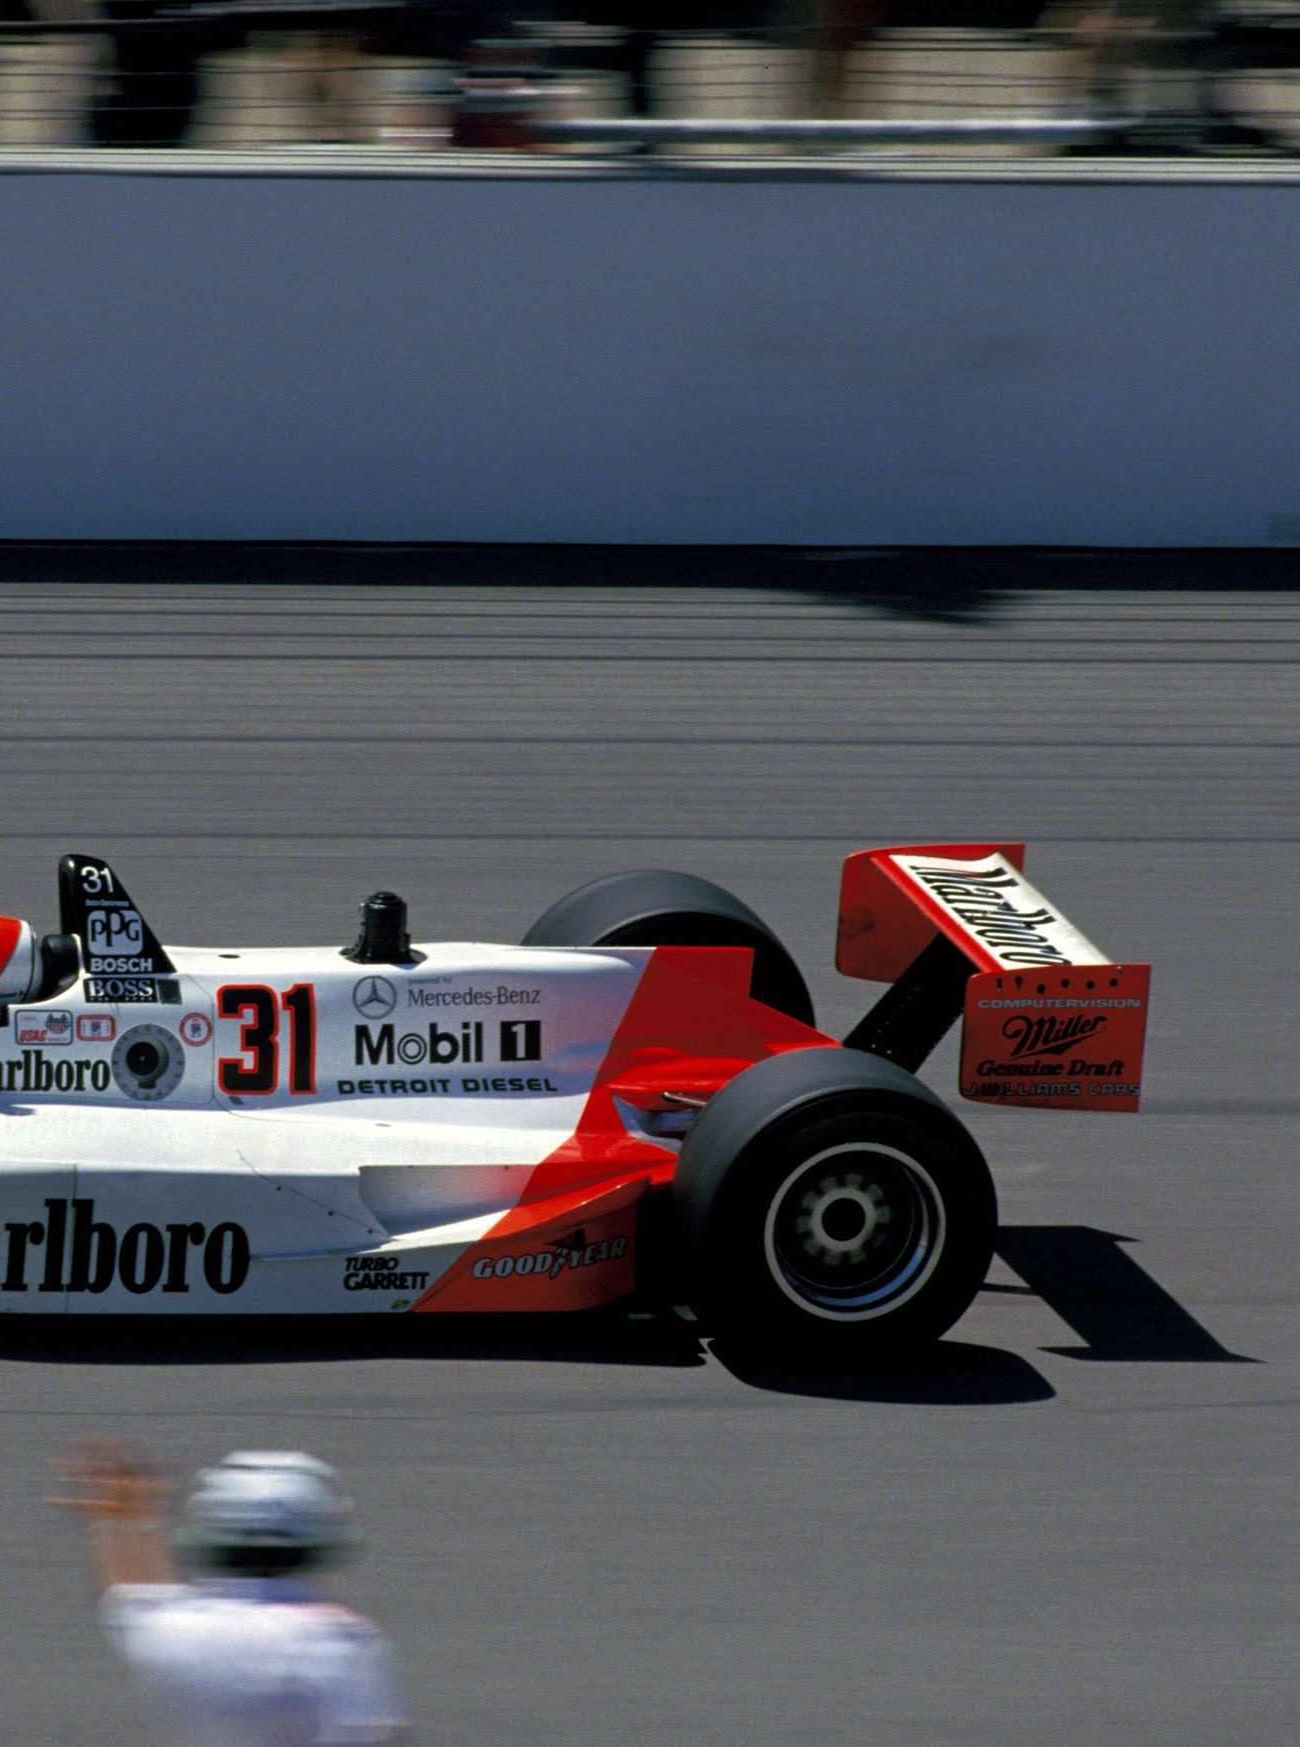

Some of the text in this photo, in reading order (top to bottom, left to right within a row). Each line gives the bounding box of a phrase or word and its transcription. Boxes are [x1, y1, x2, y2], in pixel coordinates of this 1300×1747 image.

[80, 866, 114, 893] 31
[908, 867, 1072, 964] Marlboro
[90, 911, 140, 947] PPG
[90, 958, 152, 972] BOSCH
[89, 979, 153, 997] BOSS
[407, 986, 540, 1007] Mercedes-Benz
[978, 998, 1140, 1008] COMPUTERVISION
[216, 983, 316, 1096] 31
[355, 1021, 483, 1065] Mobil
[1003, 1014, 1107, 1056] Miller
[977, 1060, 1125, 1076] Genuine Draft
[337, 1078, 557, 1094] DETROIT DIESEL
[345, 1257, 399, 1272] TURBO
[472, 1237, 626, 1280] GOODYEAR
[343, 1272, 430, 1291] GARRETT
